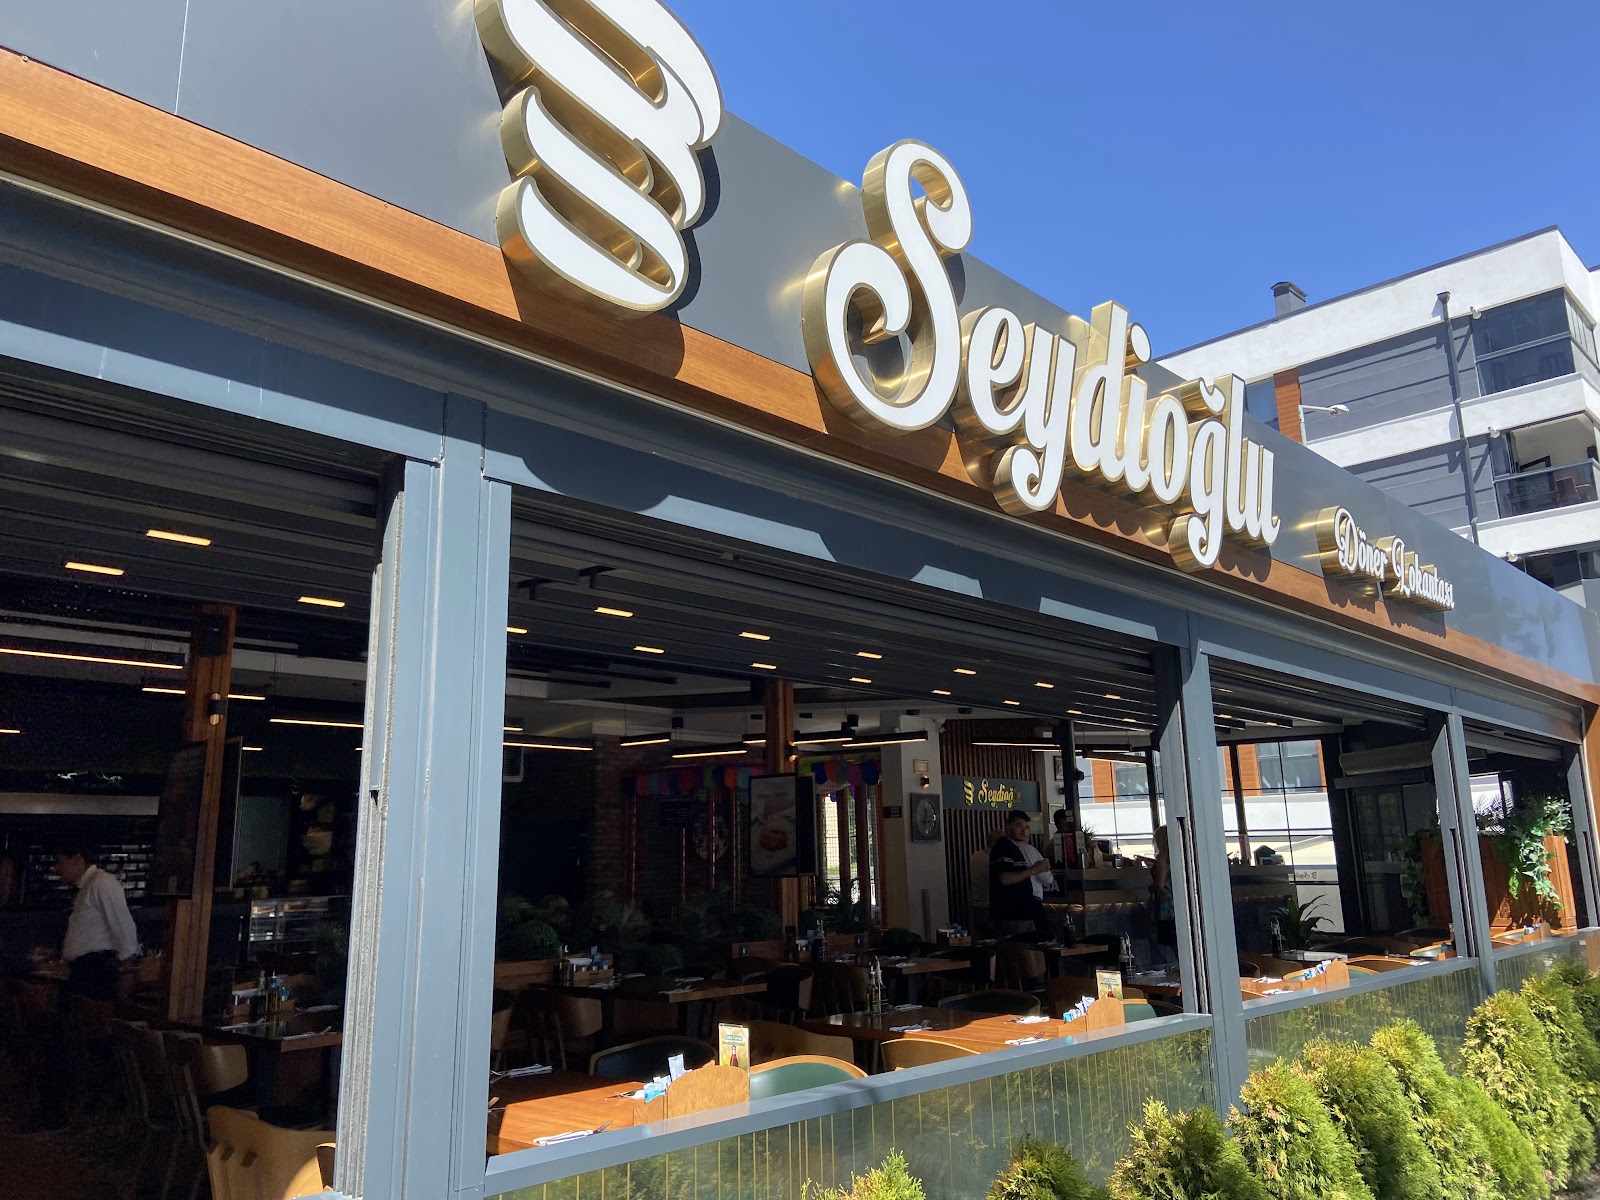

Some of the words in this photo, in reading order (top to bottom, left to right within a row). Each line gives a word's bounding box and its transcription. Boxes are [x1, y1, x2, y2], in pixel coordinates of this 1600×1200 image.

[814, 138, 1281, 570] Seydioğlu
[1332, 506, 1388, 583] Döner
[1391, 536, 1455, 609] Lokantası
